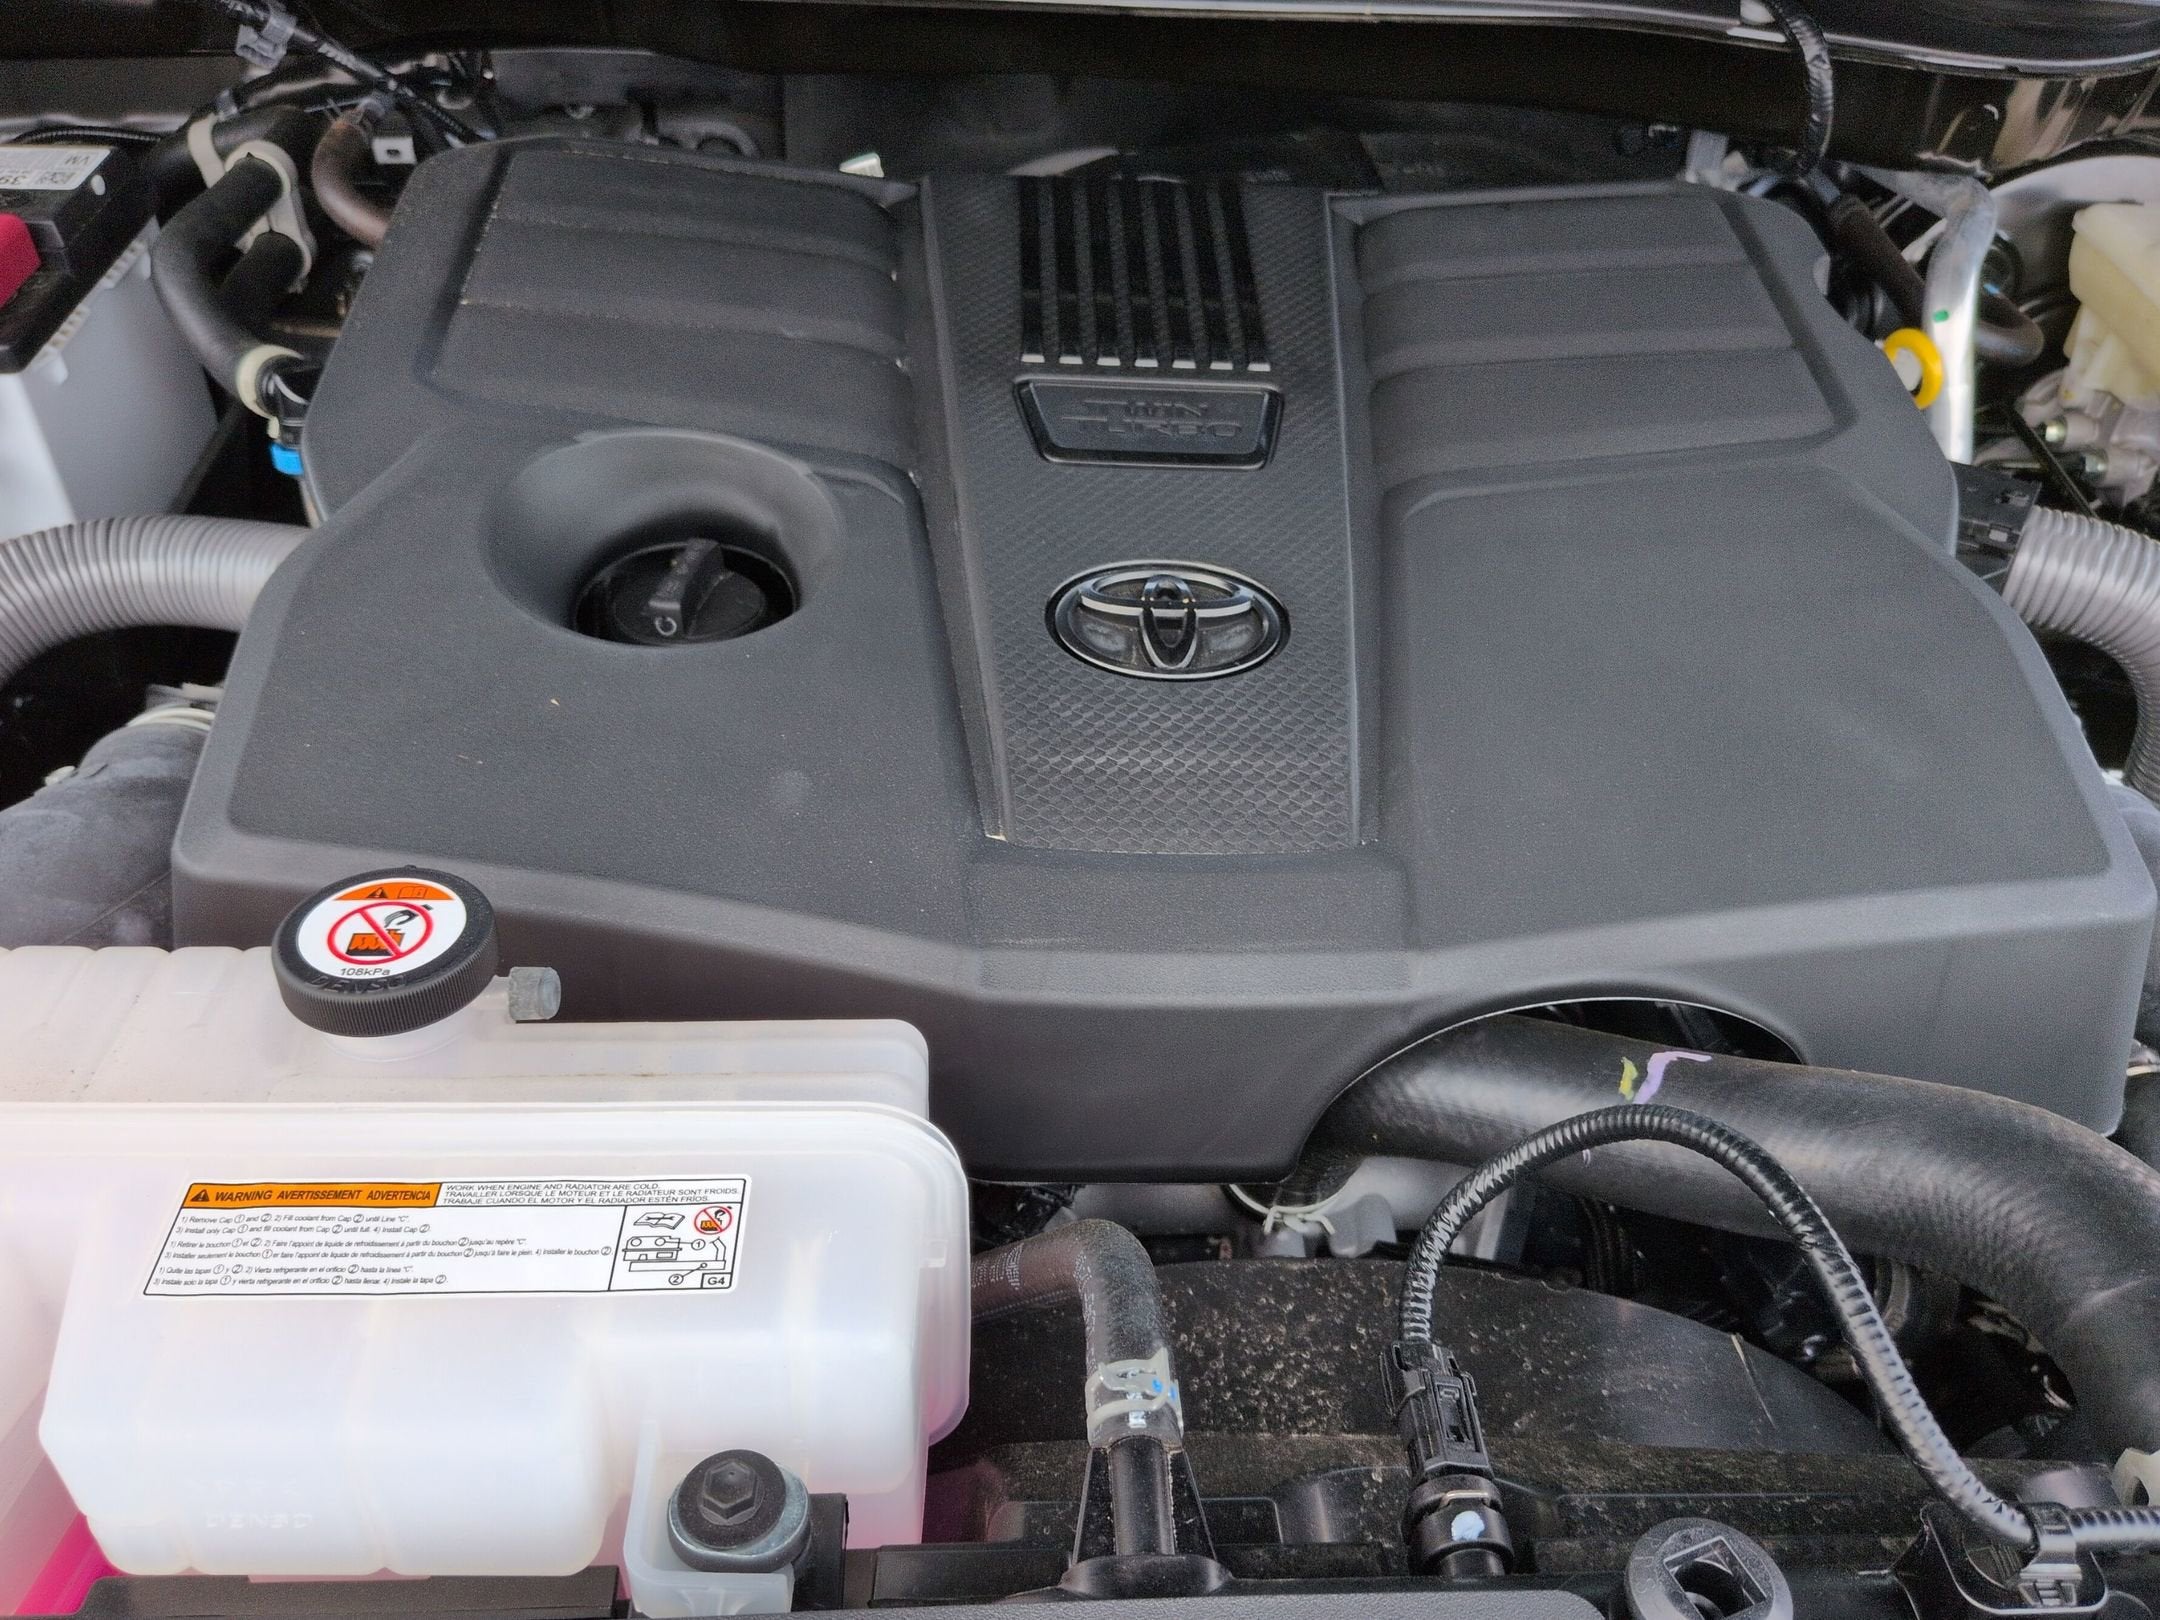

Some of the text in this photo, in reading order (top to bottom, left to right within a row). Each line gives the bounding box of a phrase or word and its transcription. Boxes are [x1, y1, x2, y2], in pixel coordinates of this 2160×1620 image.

[1084, 400, 1209, 419] TWIN
[1060, 415, 1243, 438] TURBO
[339, 967, 391, 977] 108kPa
[307, 974, 408, 994] DENSO
[214, 1190, 431, 1201] WARNING AVERTISSEMENT ADVERTENCIA
[219, 1216, 233, 1225] Cap
[222, 1227, 236, 1235] Cap
[403, 1226, 418, 1234] Cap
[707, 1276, 726, 1286] G4
[205, 1511, 313, 1528] DENSO
